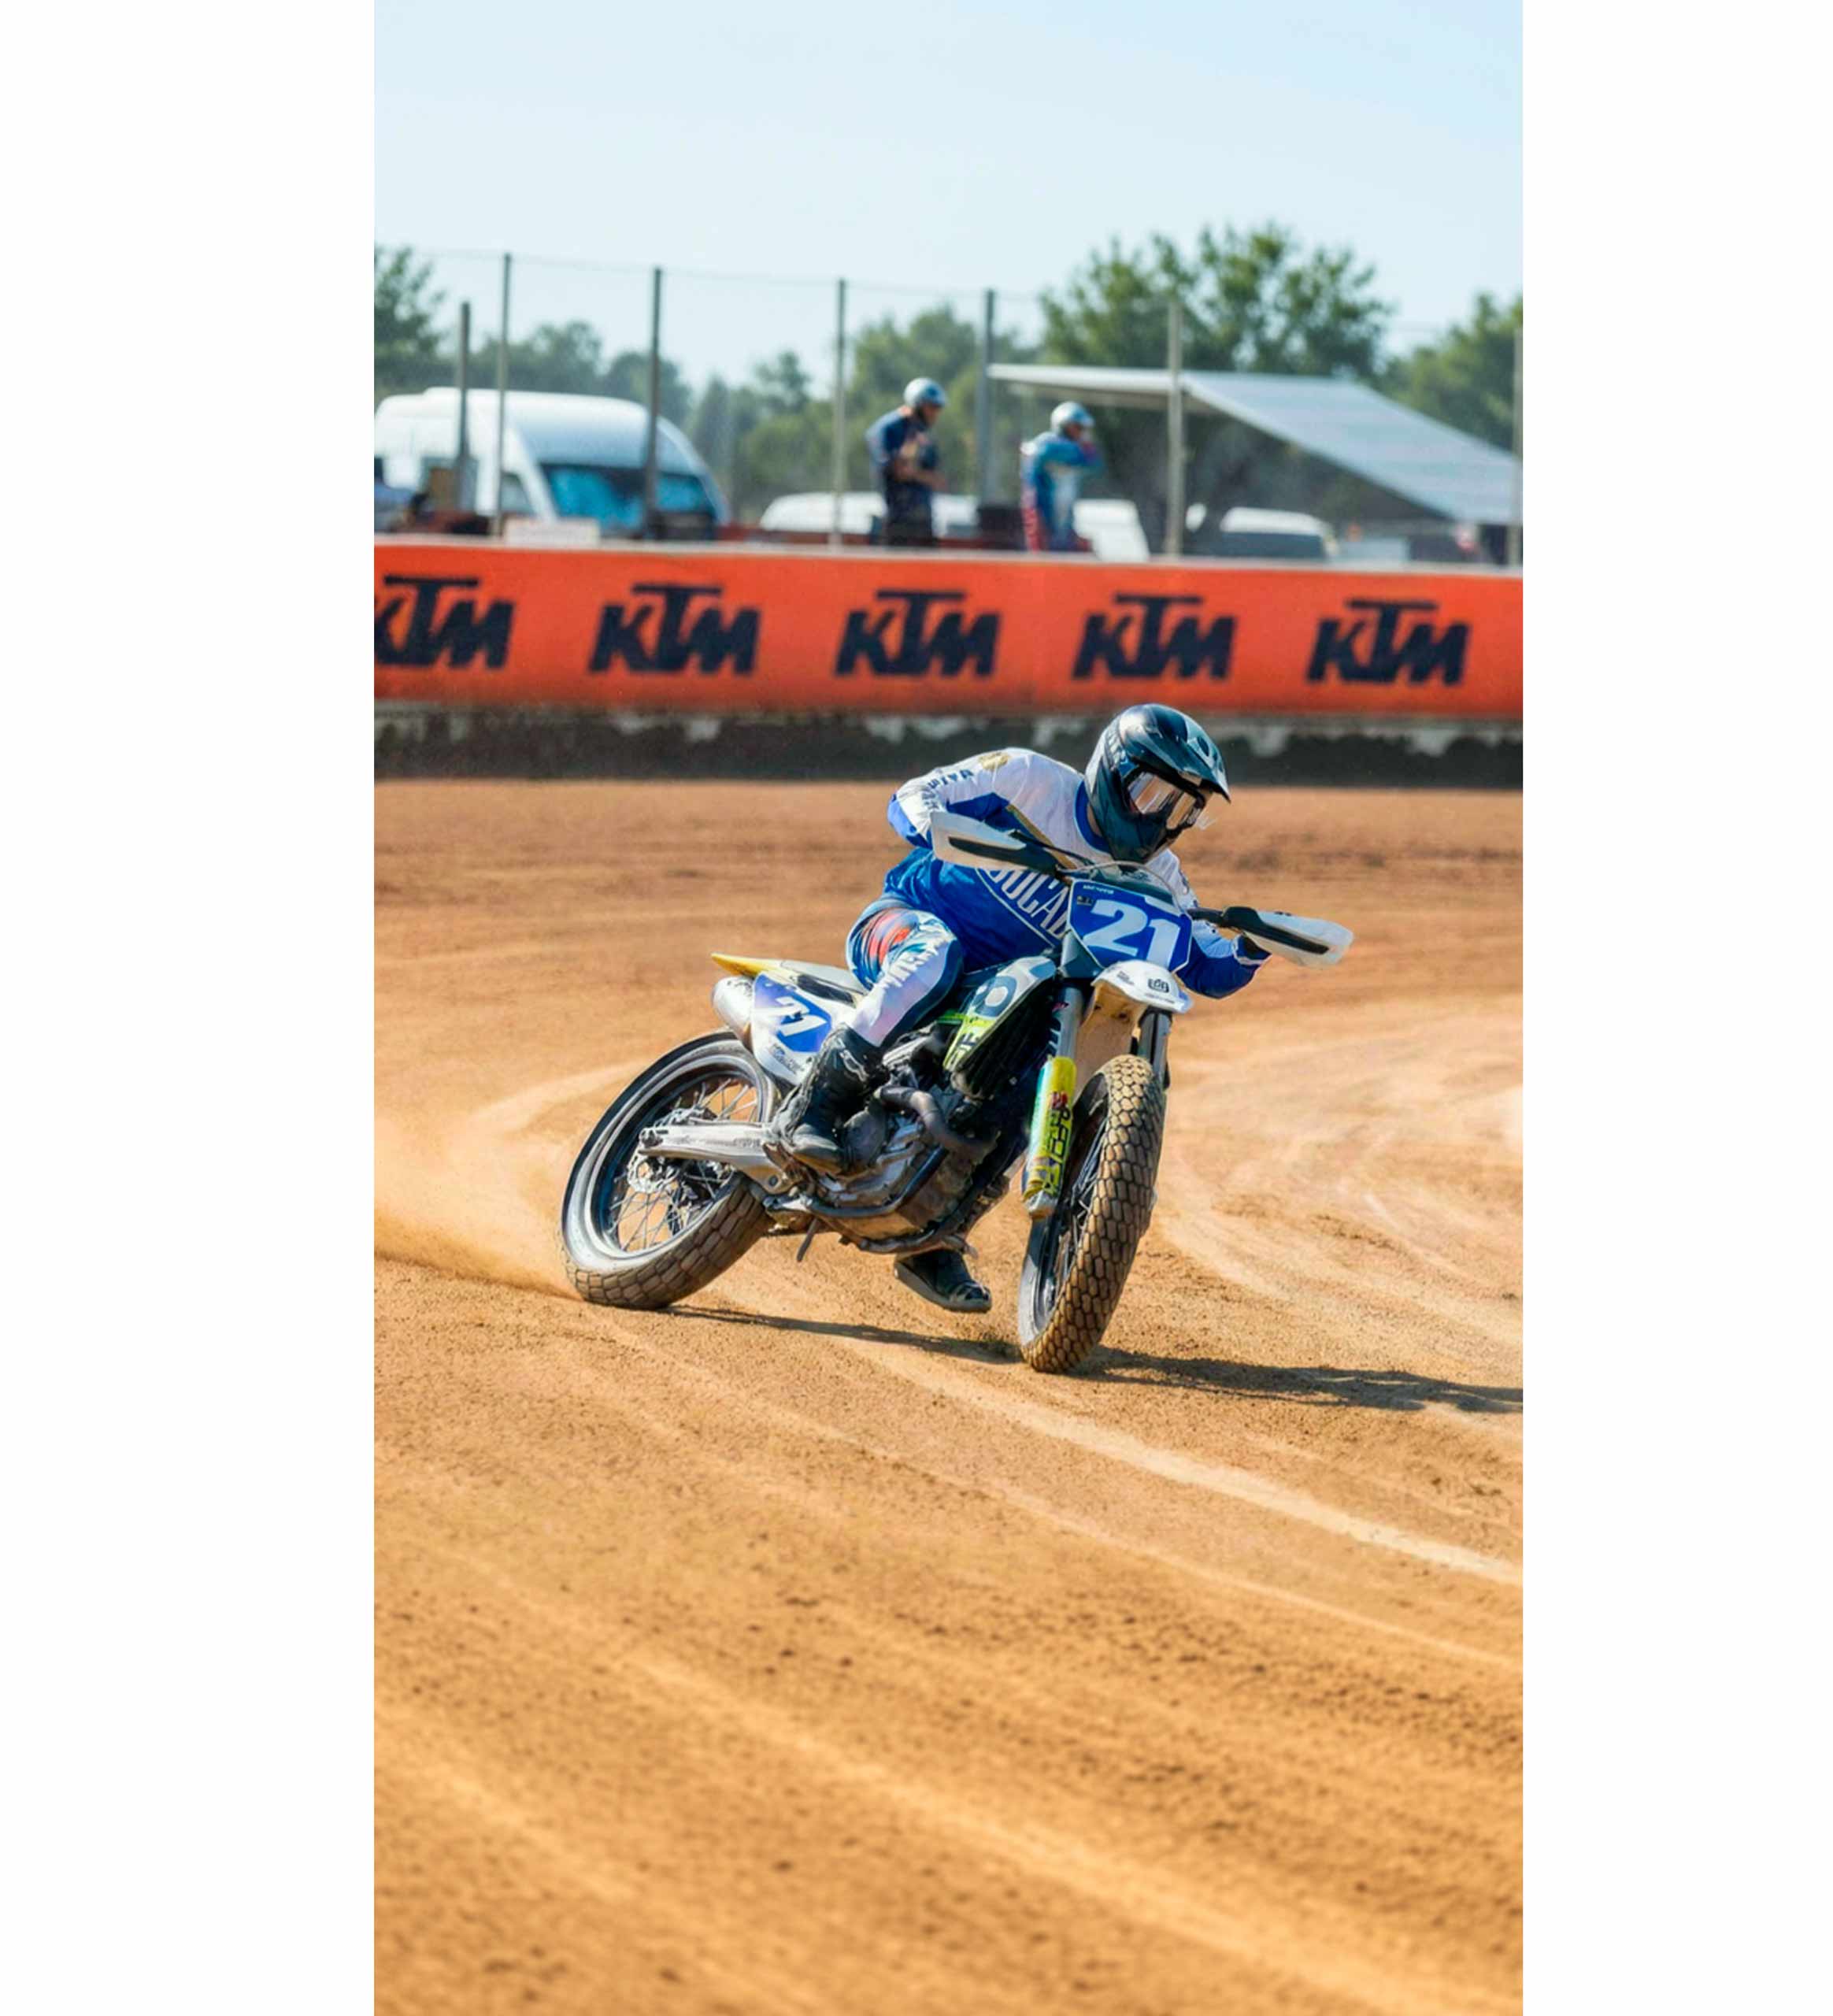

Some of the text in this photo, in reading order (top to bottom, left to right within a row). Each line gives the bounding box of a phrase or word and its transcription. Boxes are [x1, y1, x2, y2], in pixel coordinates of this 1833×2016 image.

[587, 583, 761, 678] KTM
[833, 589, 1001, 682] KTM
[1070, 594, 1237, 682] KTM
[1305, 598, 1471, 688] KTM
[1083, 899, 1180, 970] 21
